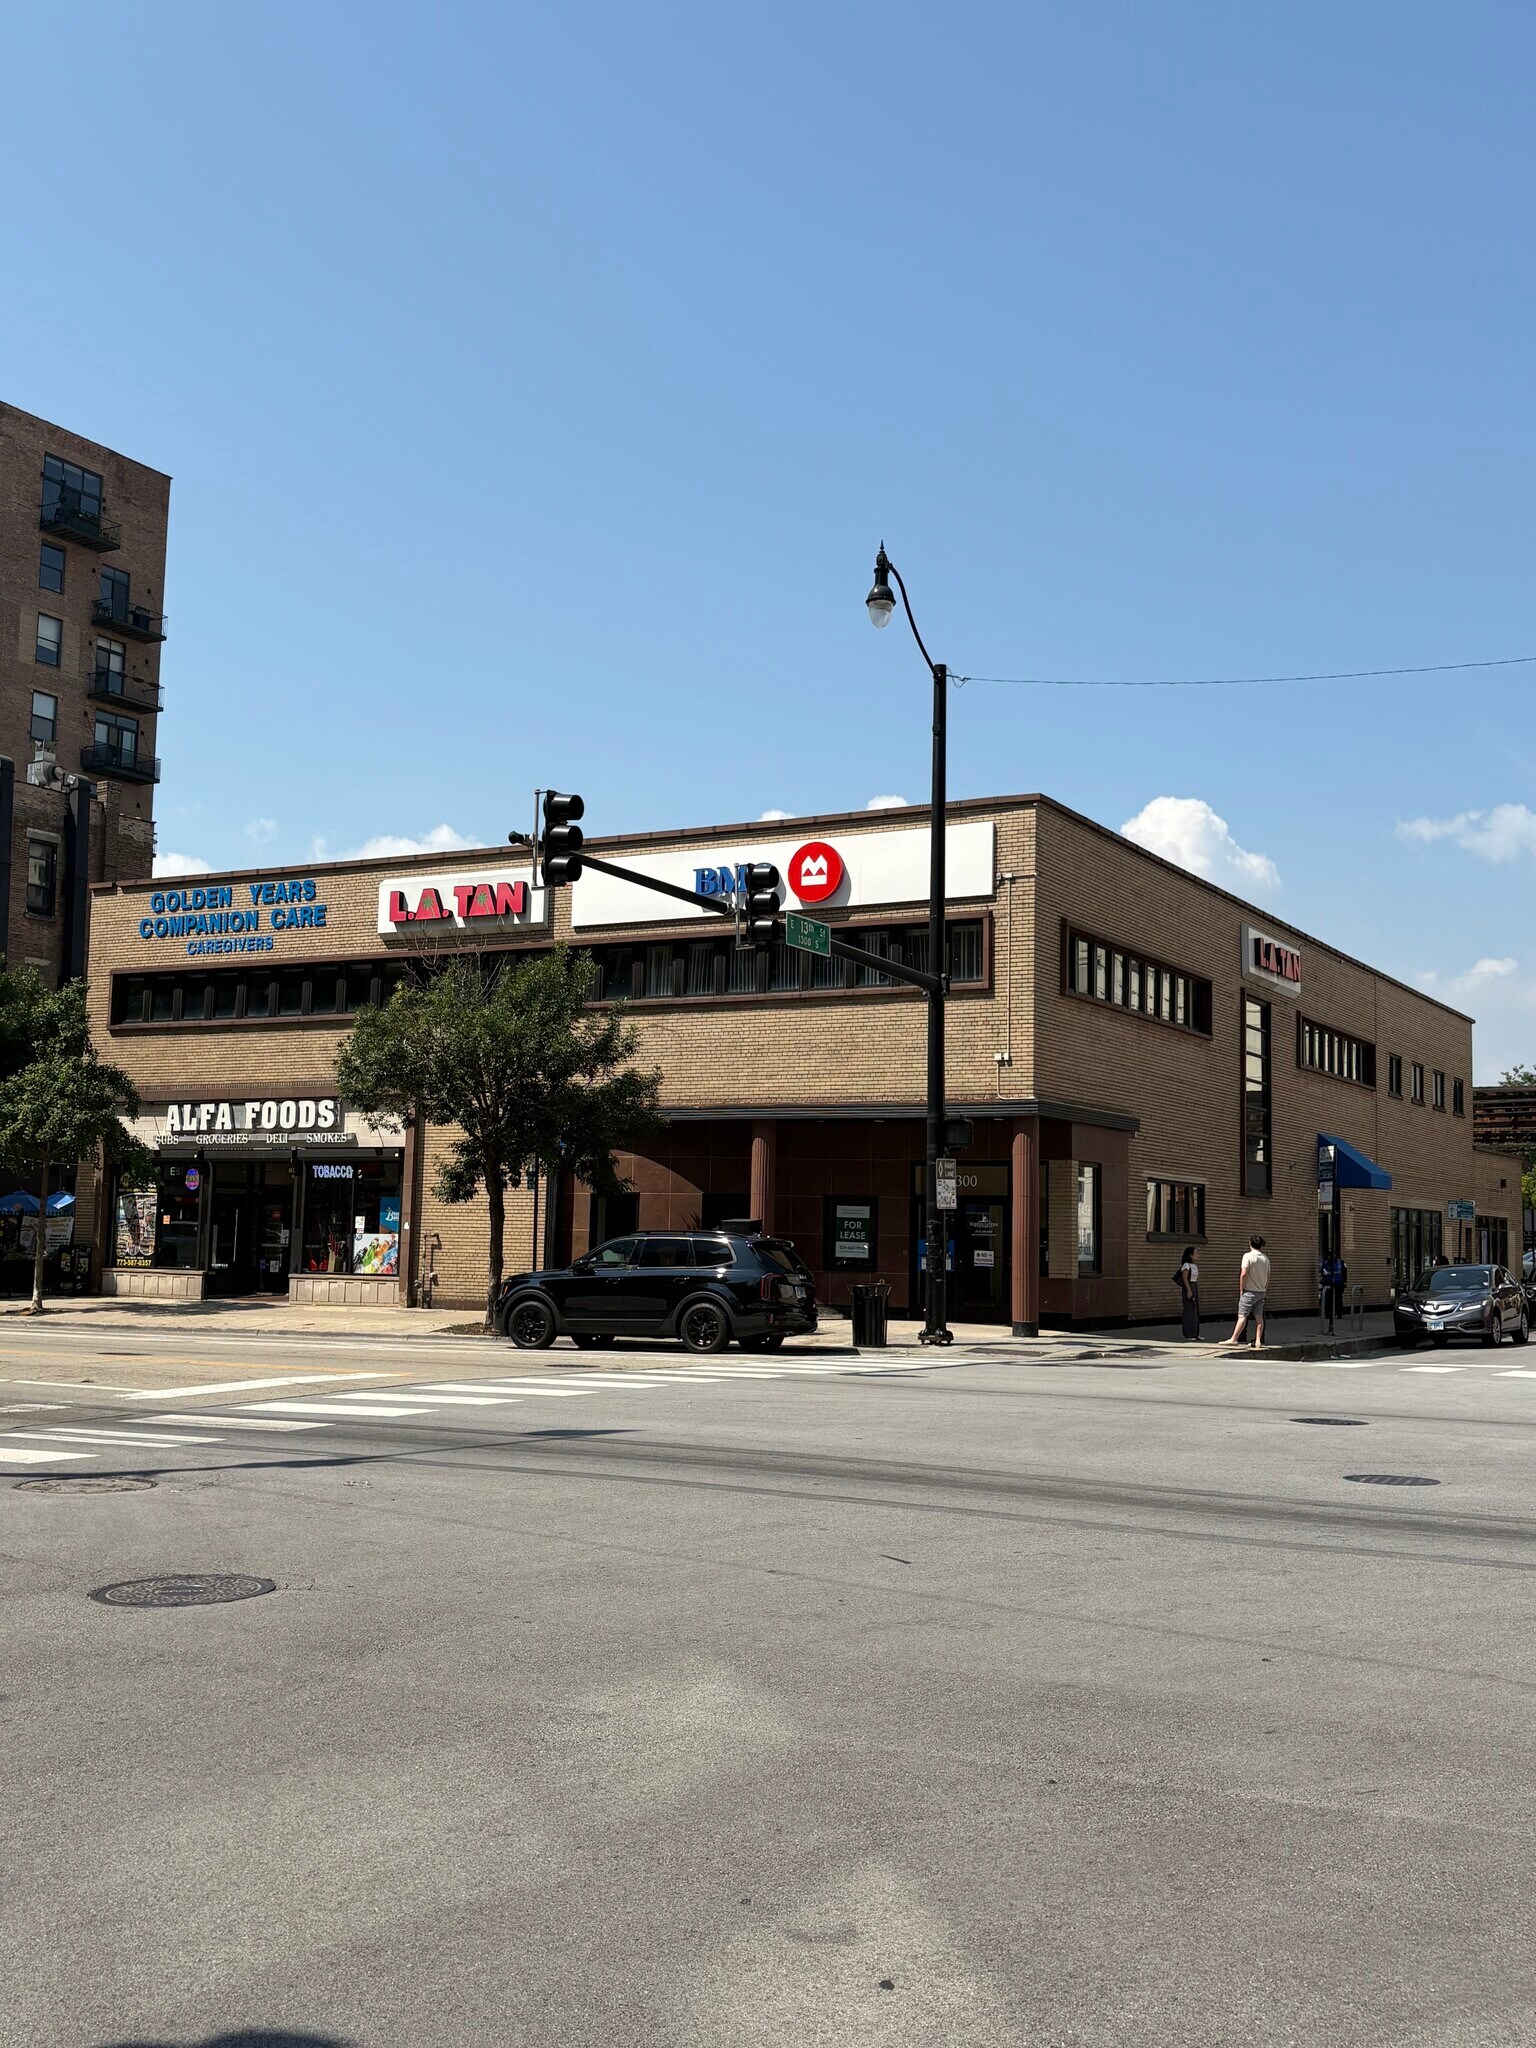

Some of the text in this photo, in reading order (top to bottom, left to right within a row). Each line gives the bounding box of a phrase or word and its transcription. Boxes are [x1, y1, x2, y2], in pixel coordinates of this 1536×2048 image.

[693, 862, 772, 895] BM
[151, 879, 316, 913] GOLDEN YEARS
[389, 881, 528, 922] L.A. TAN
[139, 905, 327, 938] COMPANION CARE
[790, 919, 795, 929] E
[800, 920, 815, 935] 13th
[186, 936, 273, 956] CAREGIVERS
[798, 934, 819, 949] 1300 S
[165, 1099, 335, 1132] ALFA FOODS
[155, 1132, 347, 1145] SUBS GROCERIES DELI SMOKES
[955, 1175, 977, 1187] 300
[844, 1221, 862, 1230] FOR
[840, 1231, 866, 1240] LEASE
